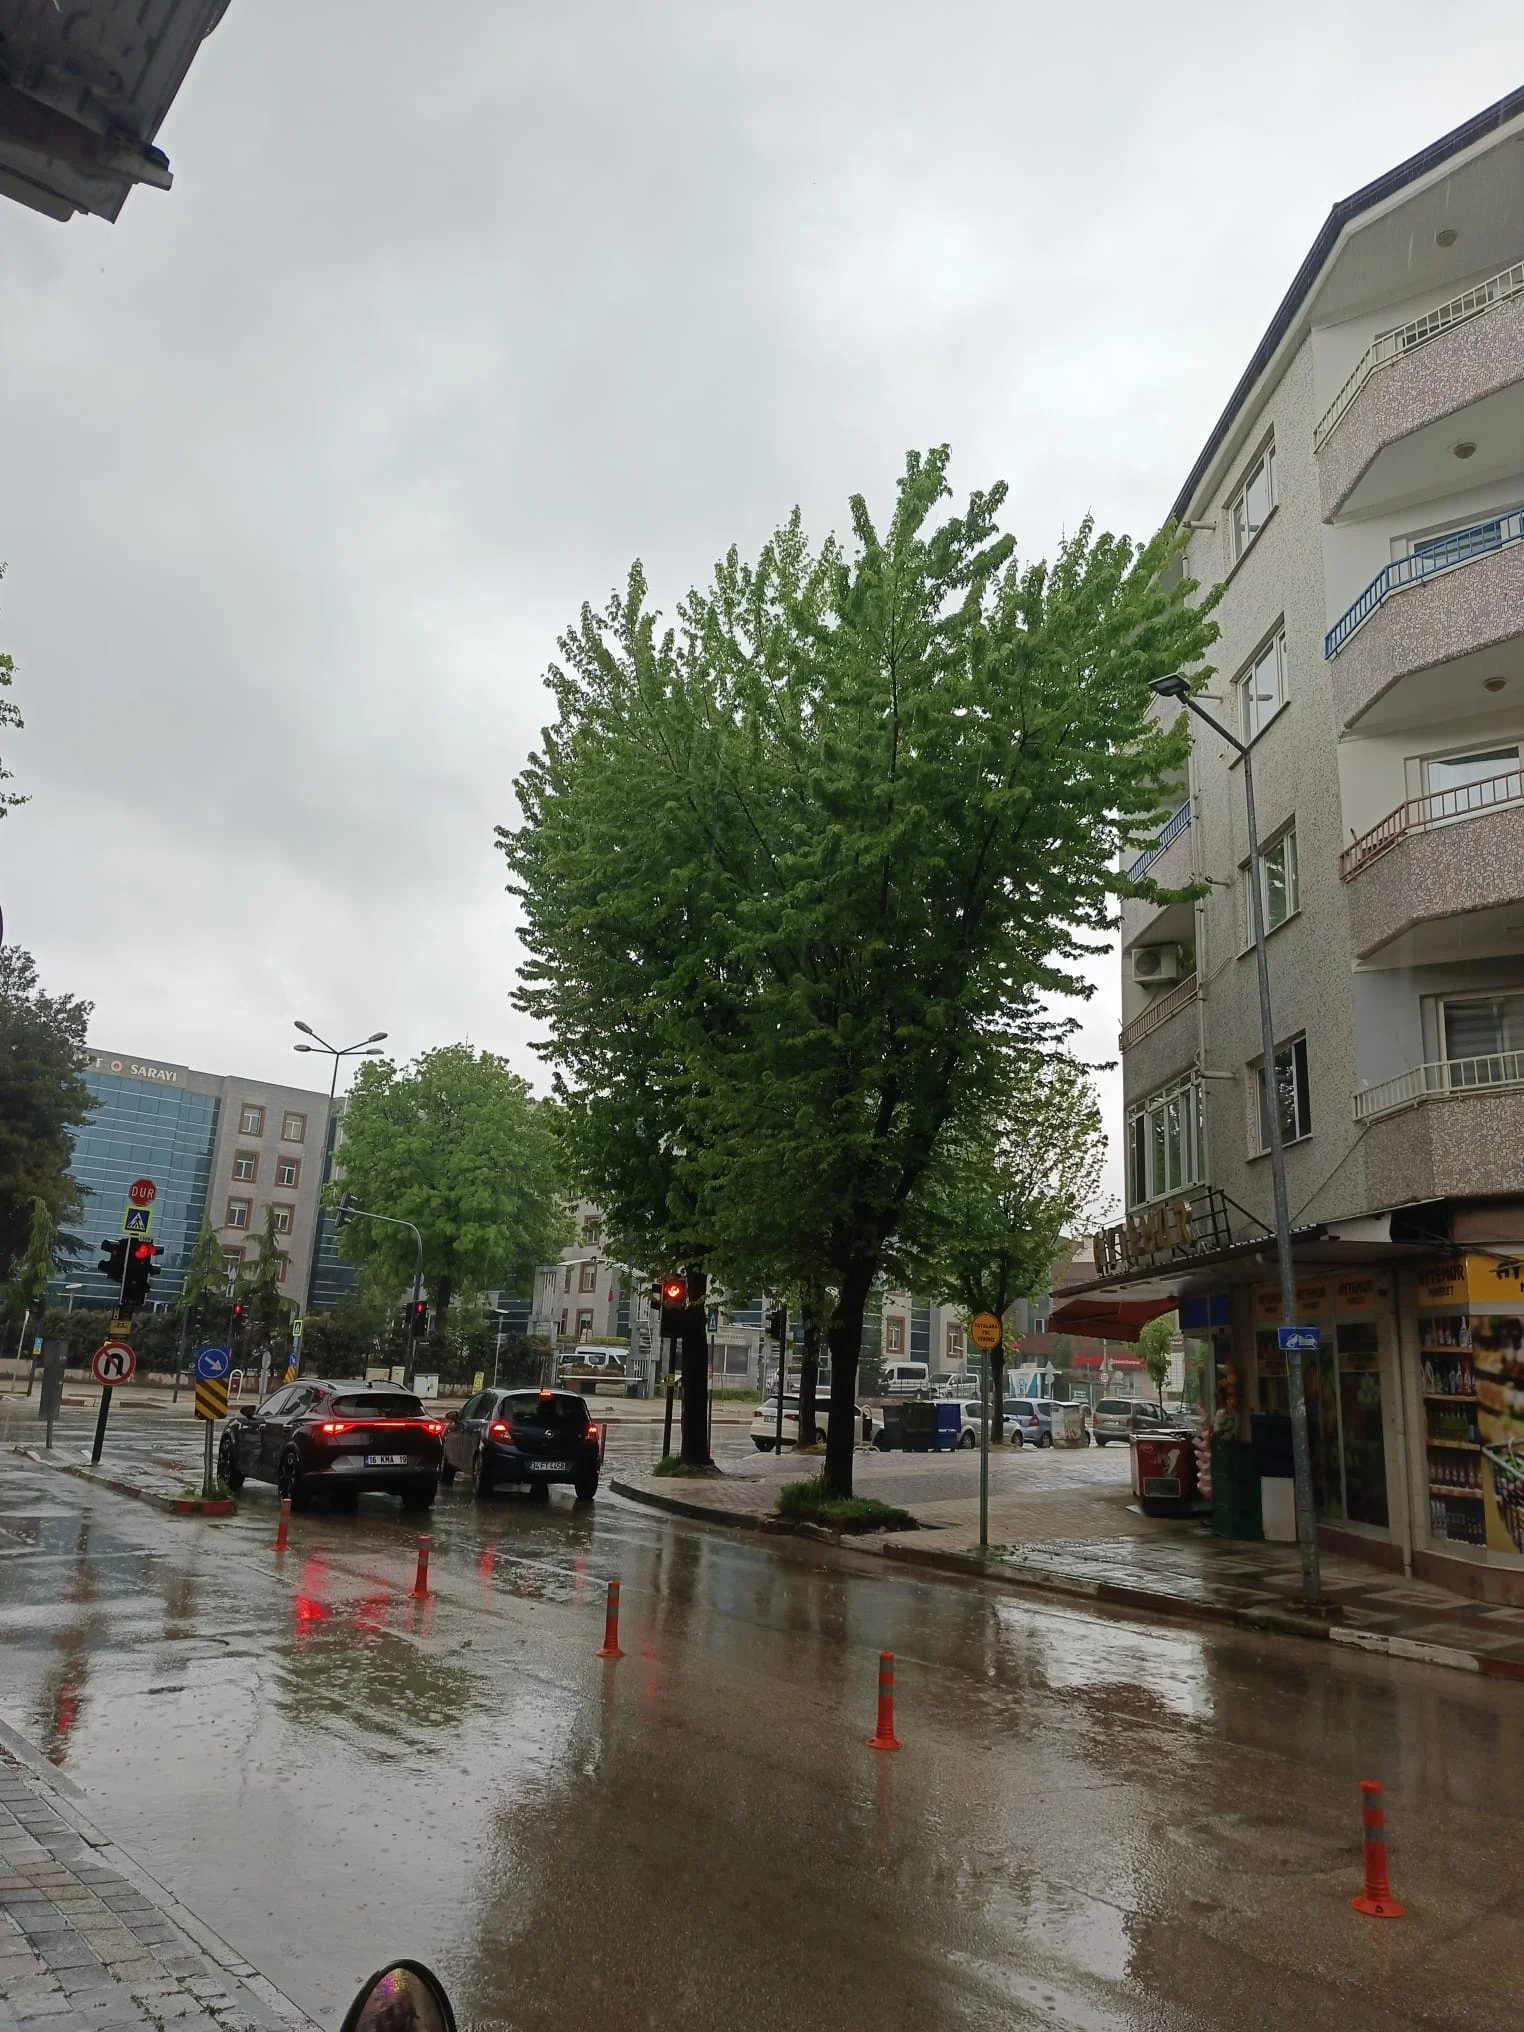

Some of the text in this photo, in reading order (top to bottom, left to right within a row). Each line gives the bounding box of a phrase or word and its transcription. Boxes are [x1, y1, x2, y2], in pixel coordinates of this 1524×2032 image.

[130, 1064, 177, 1082] SARAYI
[131, 1185, 155, 1199] DUR
[369, 1456, 377, 1464] 16
